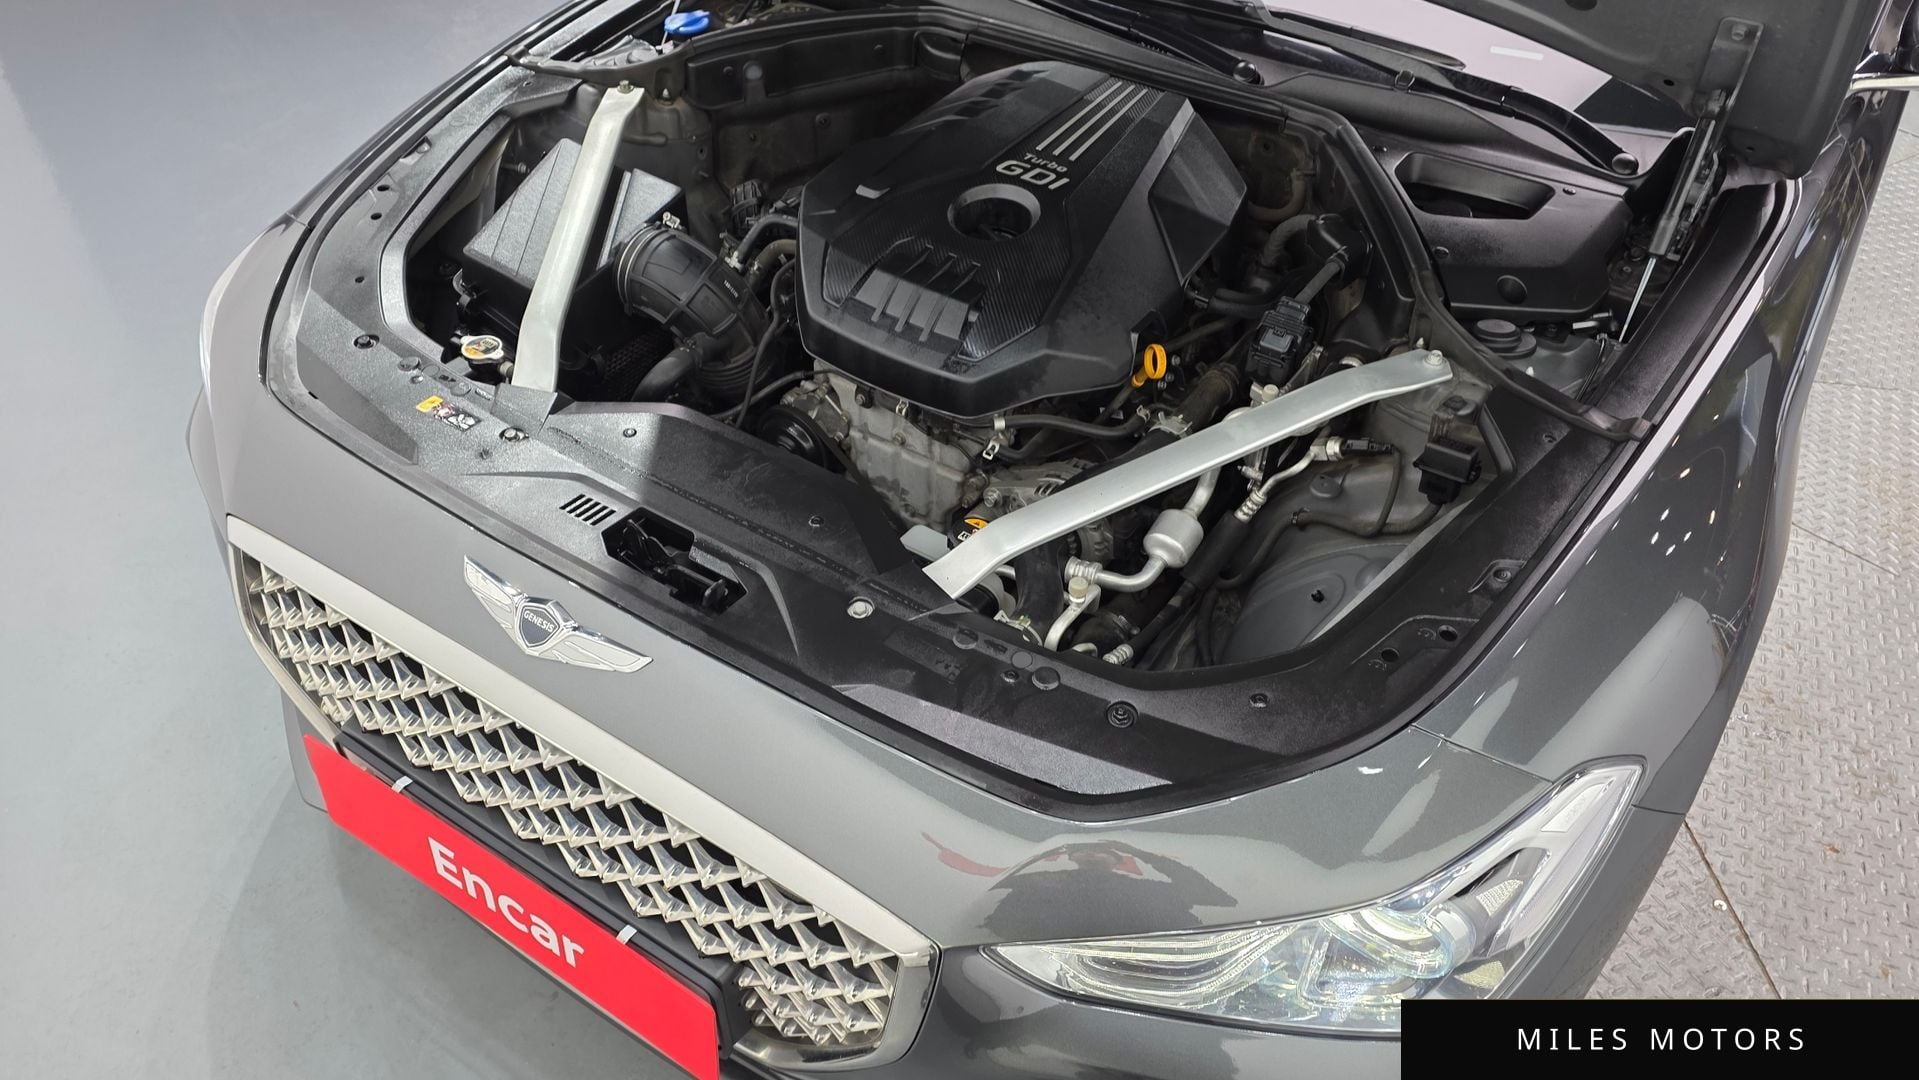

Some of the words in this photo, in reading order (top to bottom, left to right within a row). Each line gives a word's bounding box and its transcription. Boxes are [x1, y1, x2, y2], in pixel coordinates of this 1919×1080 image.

[996, 160, 1070, 190] GDI
[1024, 152, 1068, 173] Turbo
[523, 610, 555, 633] GENESIS
[428, 836, 585, 968] Encar
